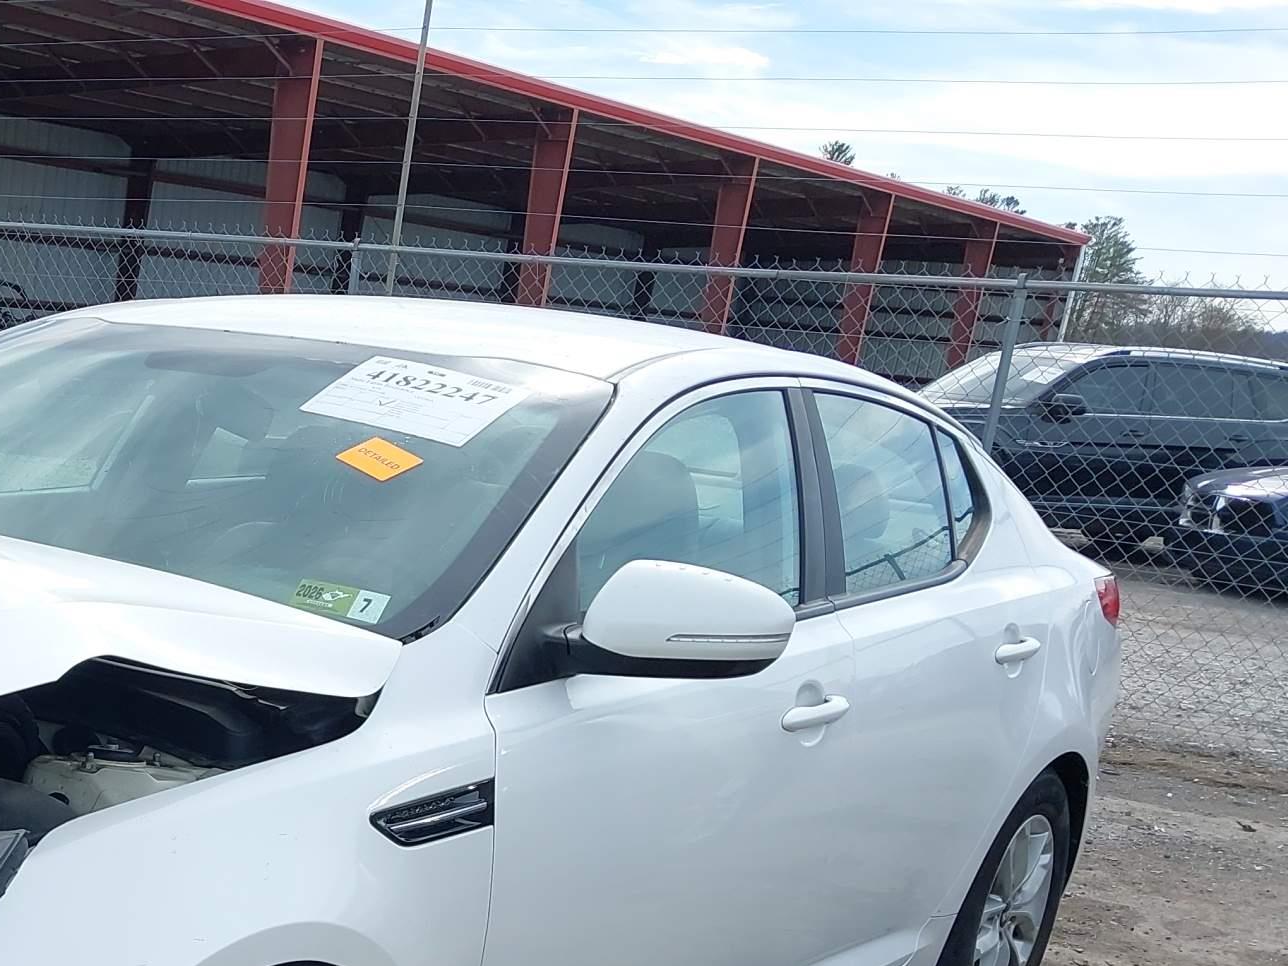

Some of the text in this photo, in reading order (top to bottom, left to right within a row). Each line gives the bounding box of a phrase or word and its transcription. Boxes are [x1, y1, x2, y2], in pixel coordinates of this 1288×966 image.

[366, 369, 499, 406] 41822247
[358, 447, 401, 470] DETAILED
[295, 583, 325, 600] 2026
[359, 597, 373, 613] 7
